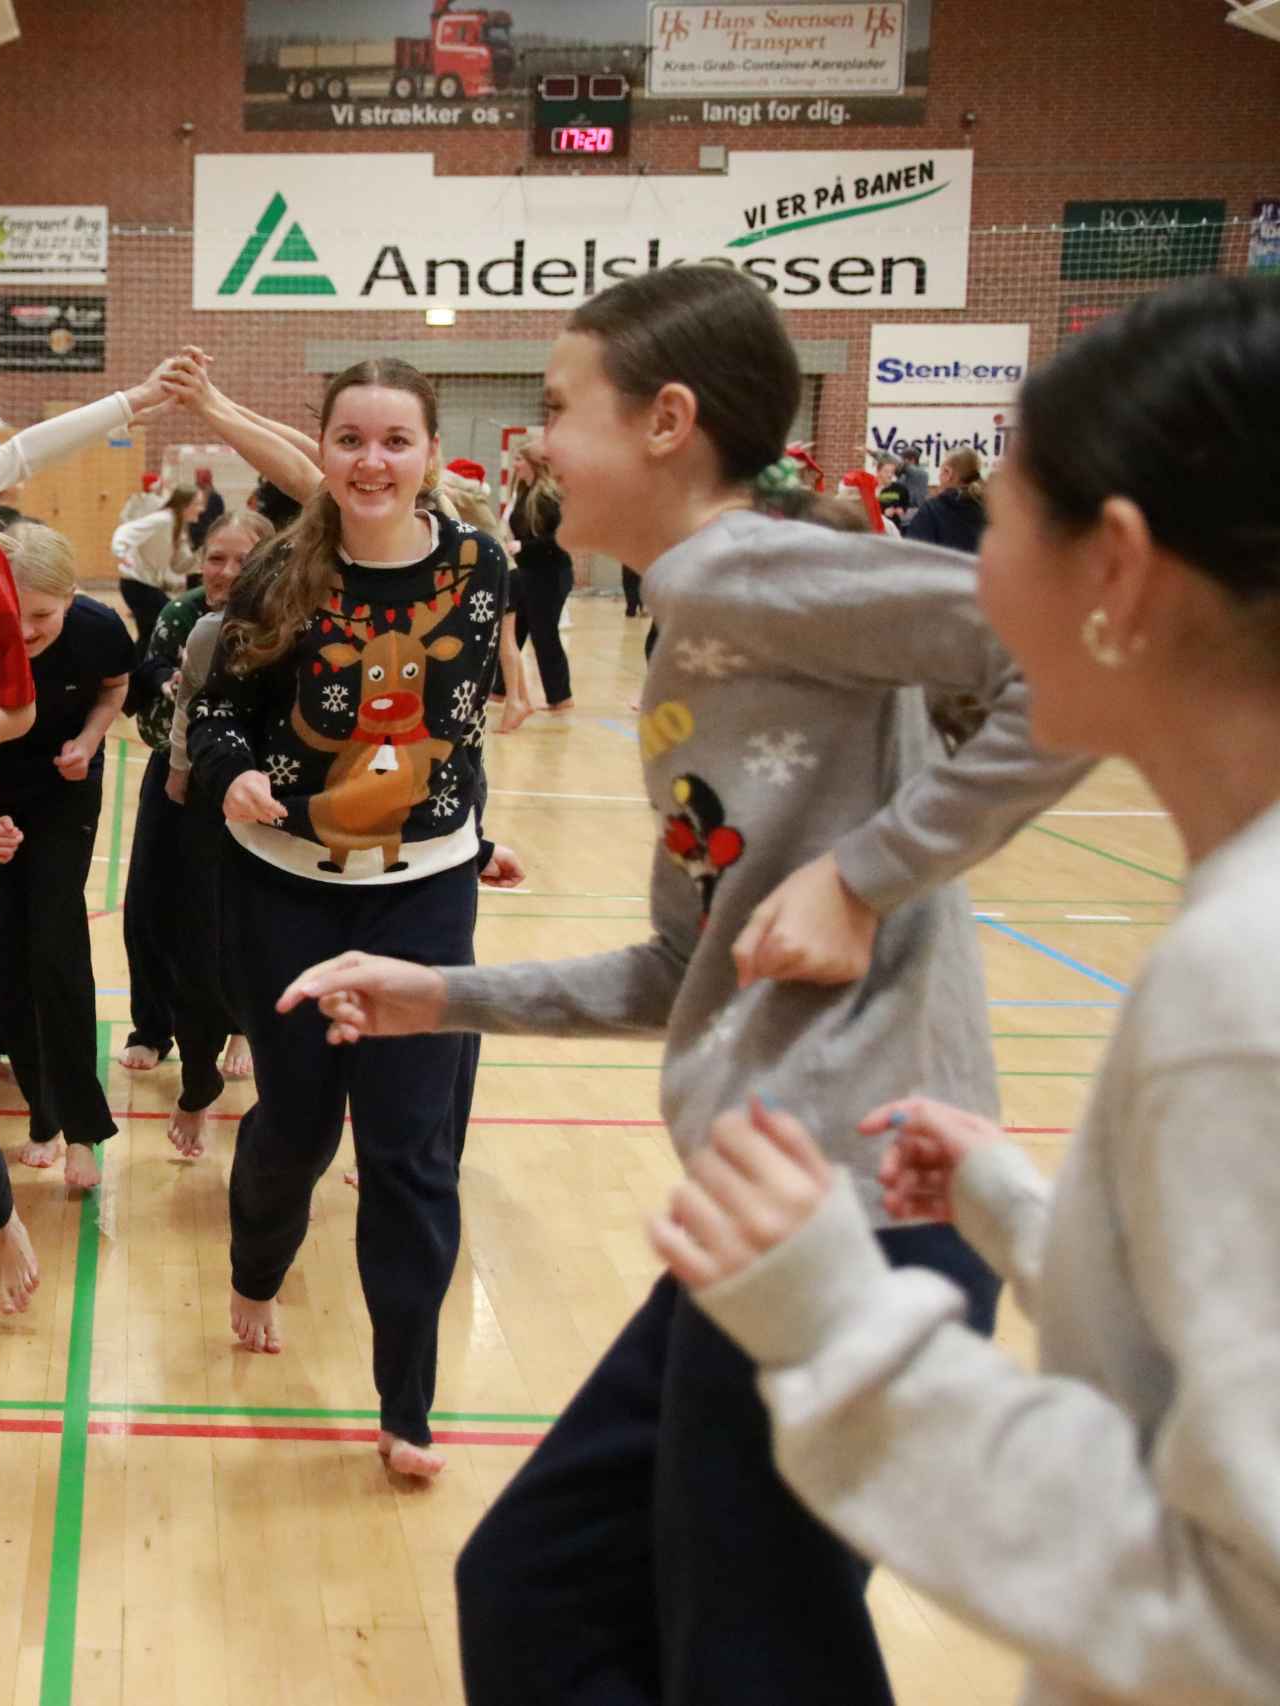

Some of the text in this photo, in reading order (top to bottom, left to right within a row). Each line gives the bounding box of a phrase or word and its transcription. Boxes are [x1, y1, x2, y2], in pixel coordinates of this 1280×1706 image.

[701, 9, 855, 29] Hans Sørensen
[727, 31, 827, 54] Transport
[331, 104, 355, 125] Vi
[360, 103, 464, 125] strækker
[471, 106, 500, 125] os
[702, 101, 762, 126] langt
[767, 100, 801, 120] for
[807, 100, 851, 125] dig.
[558, 127, 614, 151] 17:20
[744, 159, 936, 230] VI ER PÅ BANEN
[359, 237, 928, 298] Andelsssen
[876, 357, 1023, 384] Stenberg
